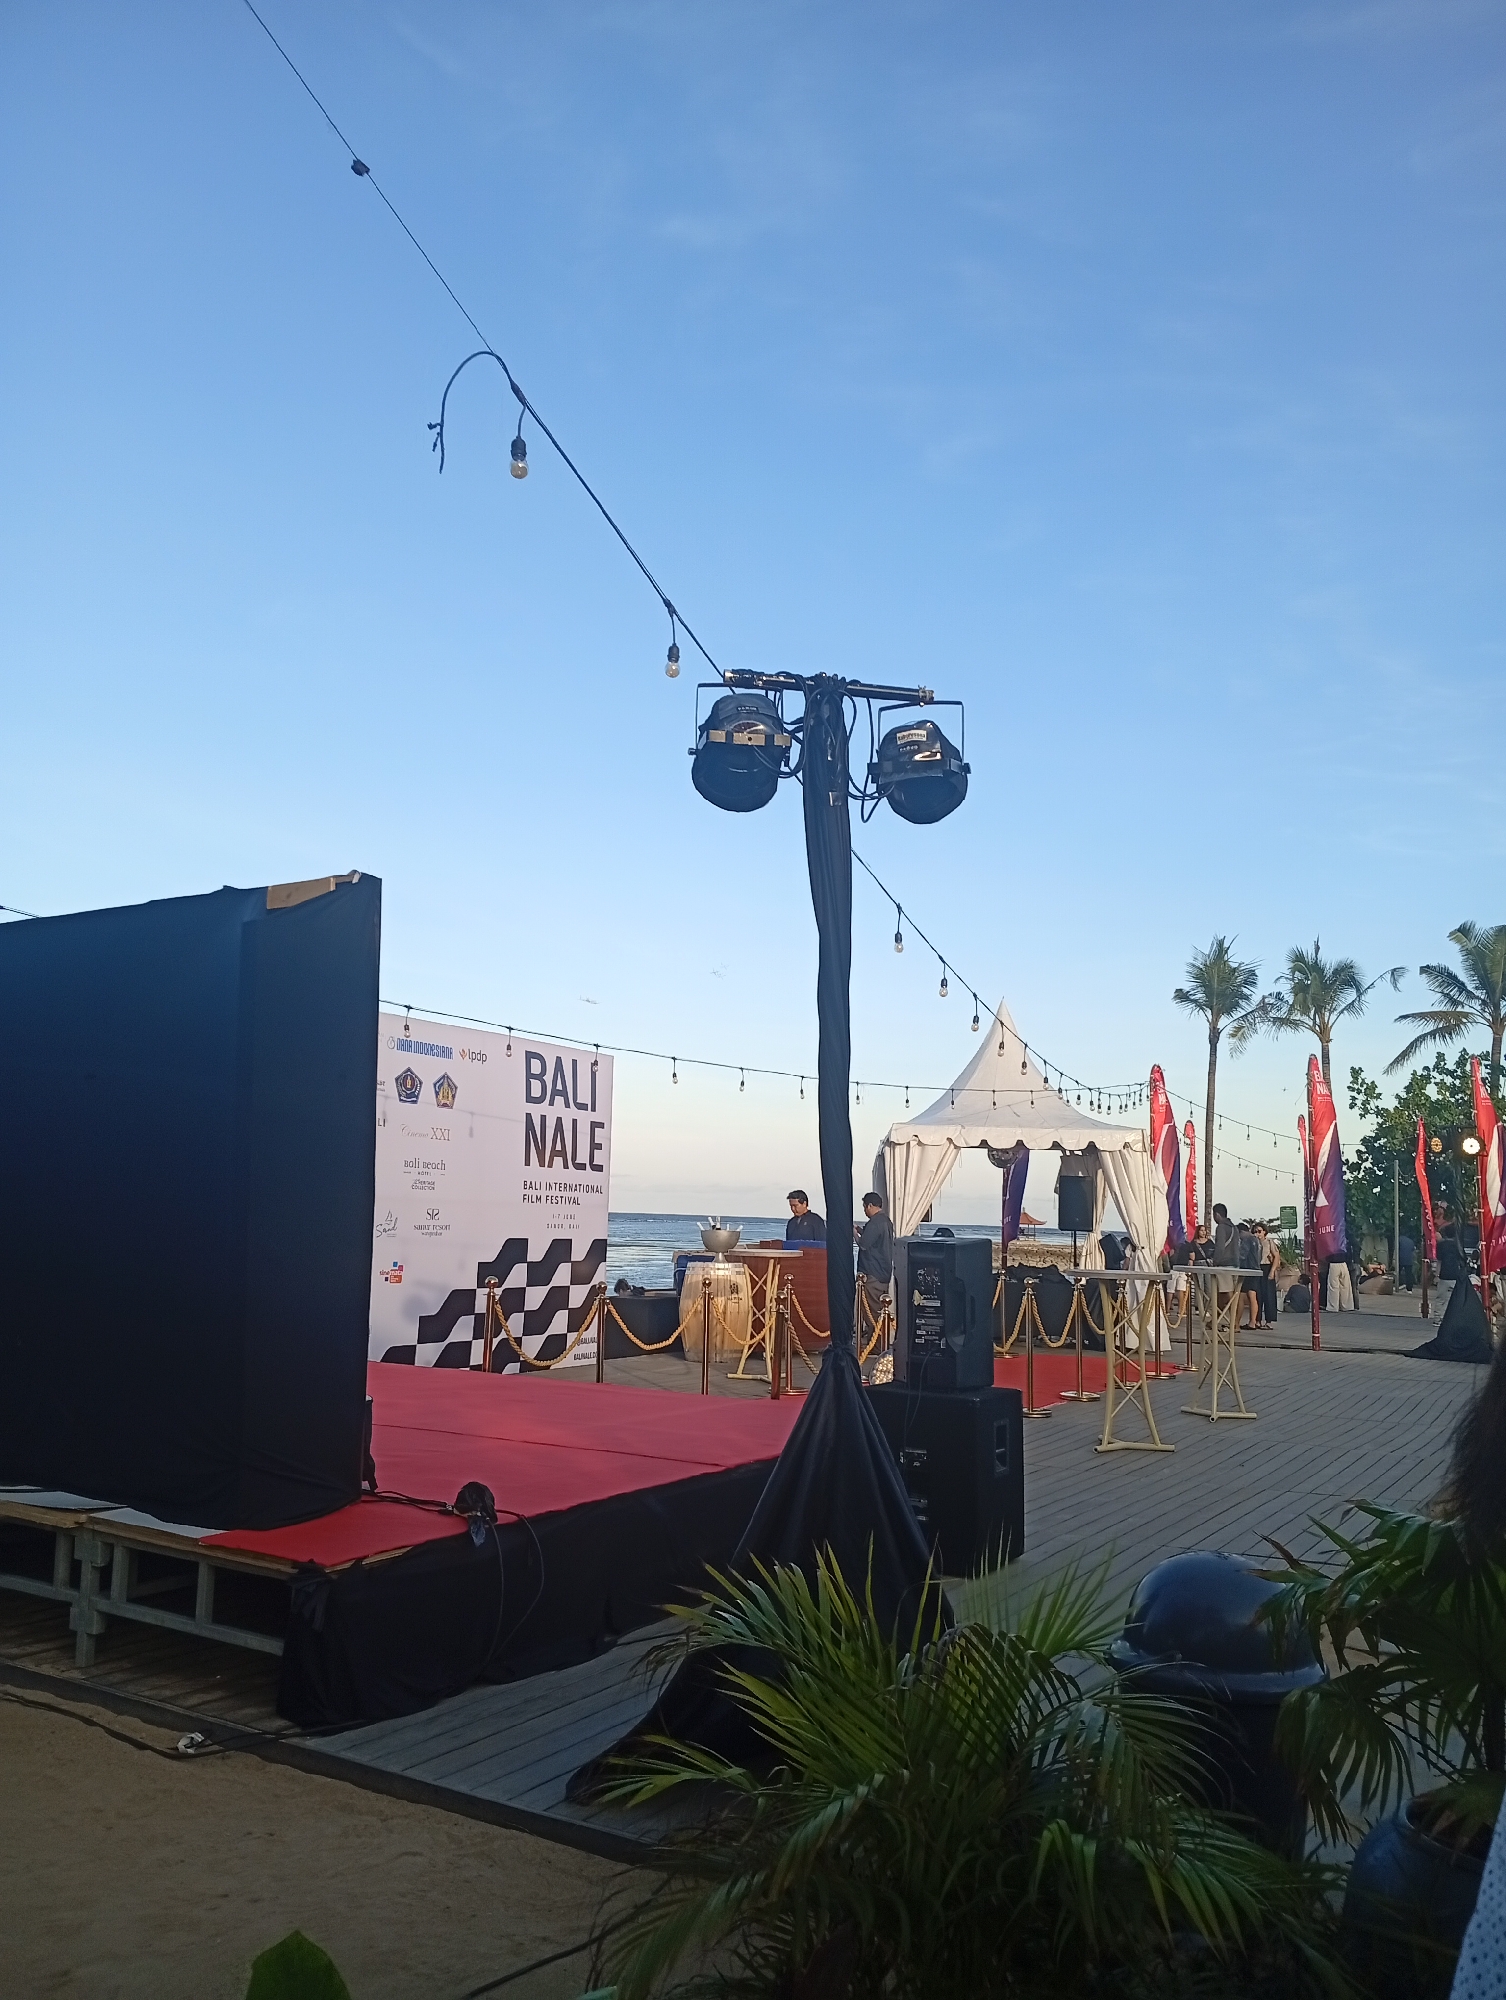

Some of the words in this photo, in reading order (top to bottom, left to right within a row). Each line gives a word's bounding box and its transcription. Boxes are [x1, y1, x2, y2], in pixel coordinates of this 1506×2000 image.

[396, 1038, 412, 1053] DANA
[468, 1048, 488, 1064] lpdp
[525, 1050, 597, 1112] BALI
[430, 1127, 451, 1141] XXI
[524, 1112, 604, 1172] NALE
[523, 1180, 542, 1191] BALI
[545, 1181, 603, 1194] INTERNATIONAL
[522, 1194, 542, 1204] FILM
[545, 1195, 581, 1206] FESTIVAL
